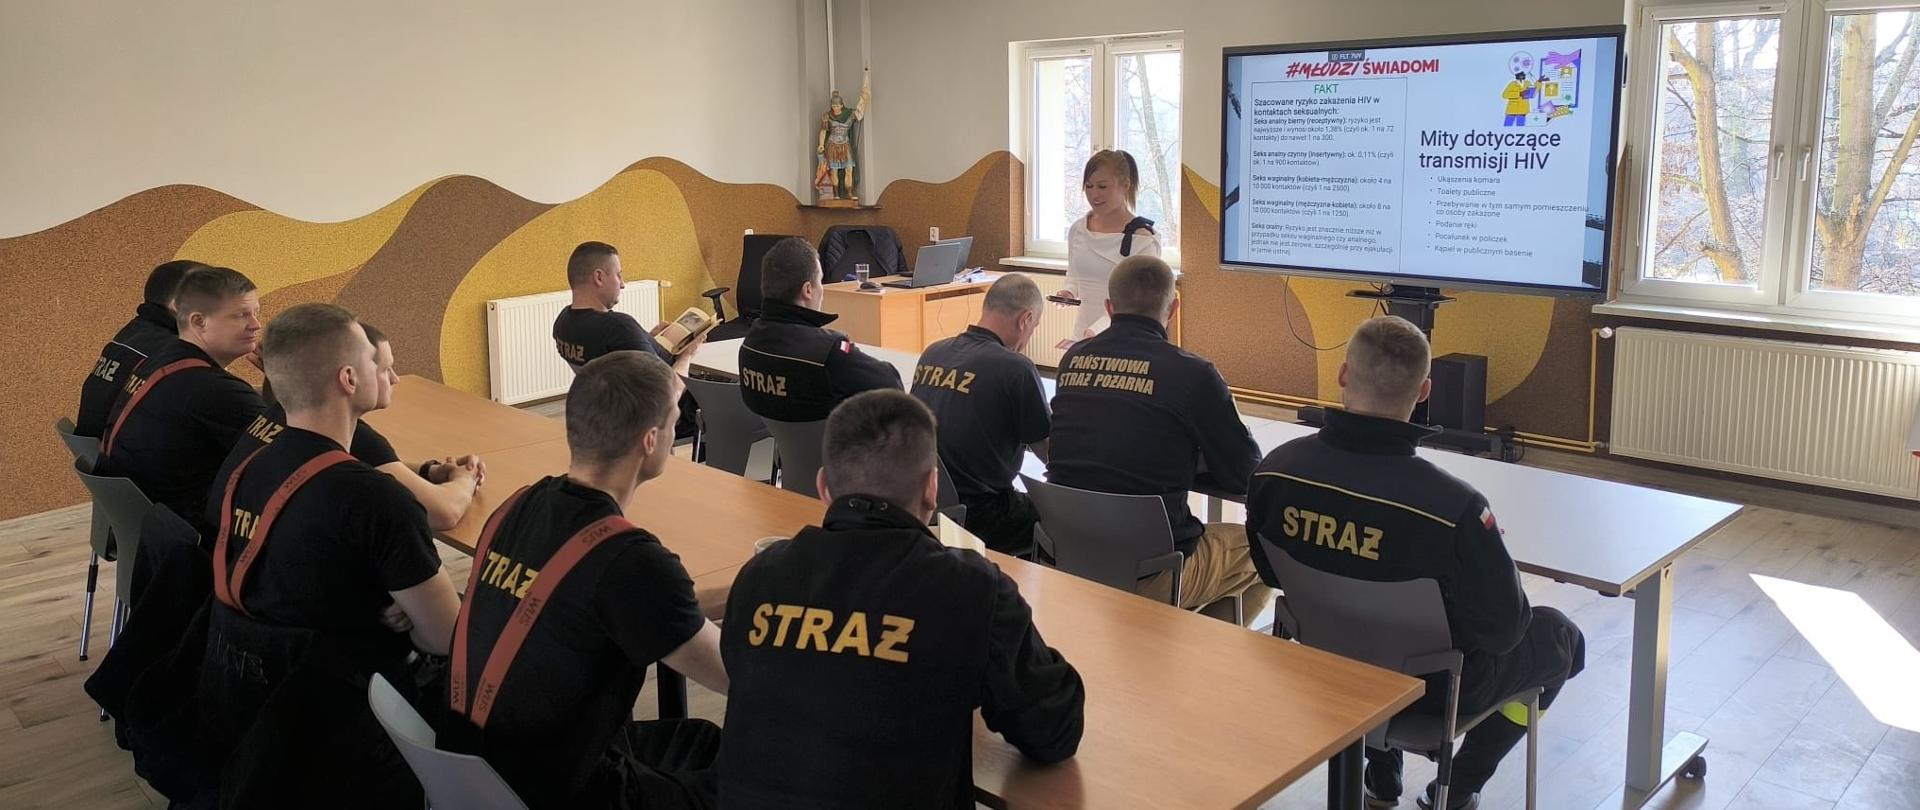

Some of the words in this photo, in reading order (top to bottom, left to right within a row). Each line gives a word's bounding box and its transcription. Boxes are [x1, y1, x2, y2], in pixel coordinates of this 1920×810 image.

[1286, 61, 1360, 79] #MŁODZI
[1363, 58, 1439, 75] ŚWIADOMI
[1314, 84, 1339, 94] FAKT
[1296, 98, 1318, 106] ryzyko
[1358, 96, 1372, 104] HIV
[1254, 108, 1292, 116] kontaktach
[1294, 106, 1339, 116] seksualnych:
[1268, 118, 1287, 126] analny
[1348, 116, 1368, 125] ryzyko
[1369, 116, 1380, 125] jest
[1421, 130, 1458, 150] Mity
[1464, 130, 1561, 150] dotyczące
[1420, 152, 1508, 174] transmisji
[1514, 152, 1550, 170] HIV
[1474, 176, 1500, 184] komara
[1438, 187, 1462, 197] Toalety
[1463, 188, 1496, 198] publiczne
[1436, 200, 1480, 209] Przebywanie
[1488, 202, 1503, 210] tym
[1504, 204, 1532, 212] samym
[1533, 204, 1589, 212] pomieszczeniu
[1446, 208, 1466, 218] osoby
[1436, 220, 1462, 228] Podanie
[1435, 232, 1470, 241] Pocałunek
[1479, 234, 1508, 243] policzek
[1464, 246, 1504, 256] publicznym
[1504, 248, 1533, 257] basenie
[1069, 354, 1150, 375] PAŃSTWOWA
[1059, 372, 1092, 388] STRAŻ
[1094, 374, 1154, 395] POŻARNA
[1283, 506, 1384, 560] STRAŻ
[519, 598, 542, 626] WUS
[749, 603, 915, 662] STRAŻ
[480, 683, 496, 713] WUS
